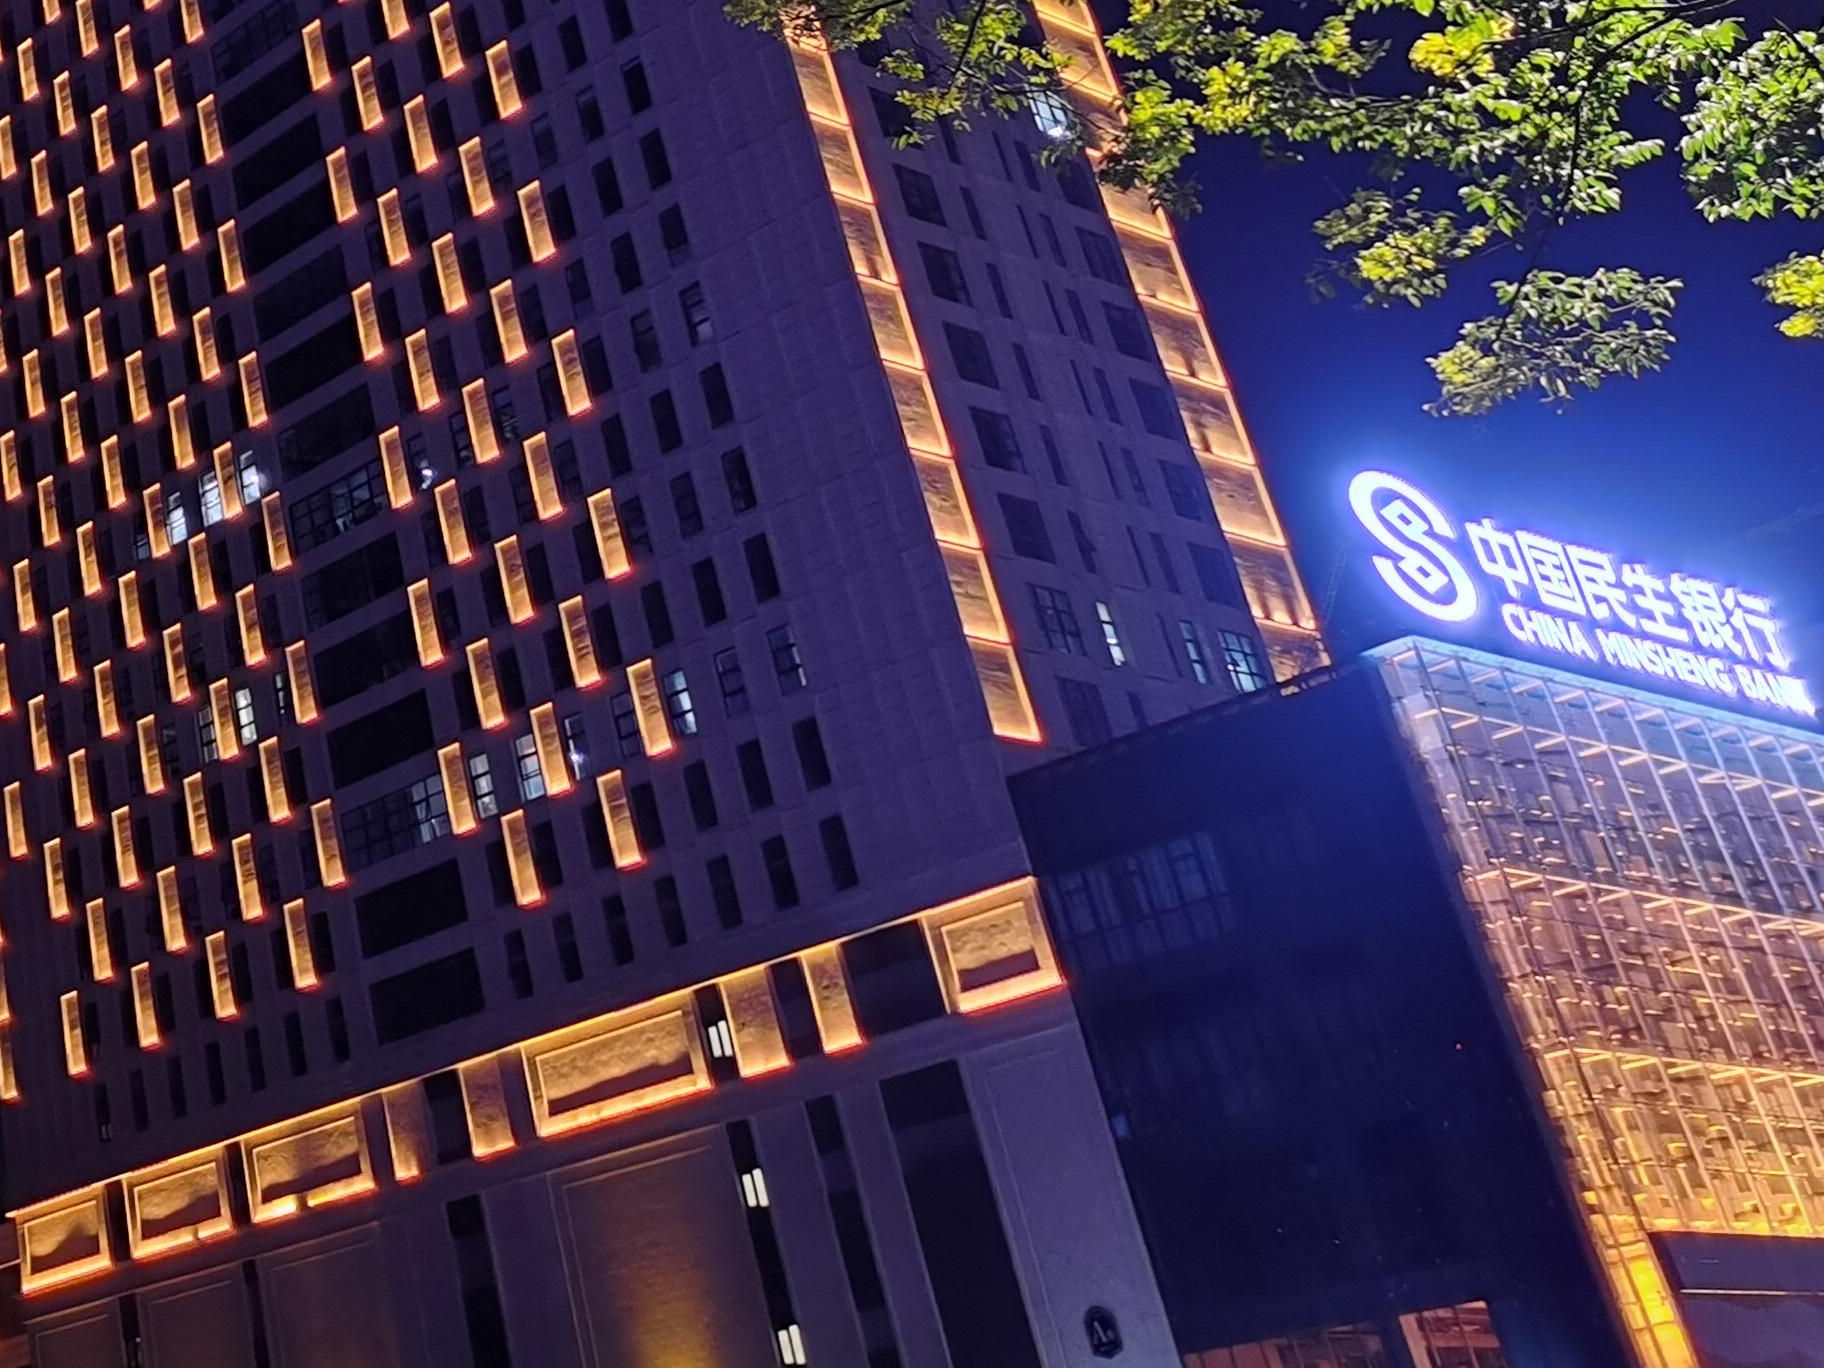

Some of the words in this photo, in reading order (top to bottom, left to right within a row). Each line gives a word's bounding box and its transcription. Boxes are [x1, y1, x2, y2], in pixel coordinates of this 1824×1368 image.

[1465, 517, 1792, 670] 中国民生银行
[1501, 603, 1598, 661] CHINA
[1595, 628, 1736, 697] MINSHENG
